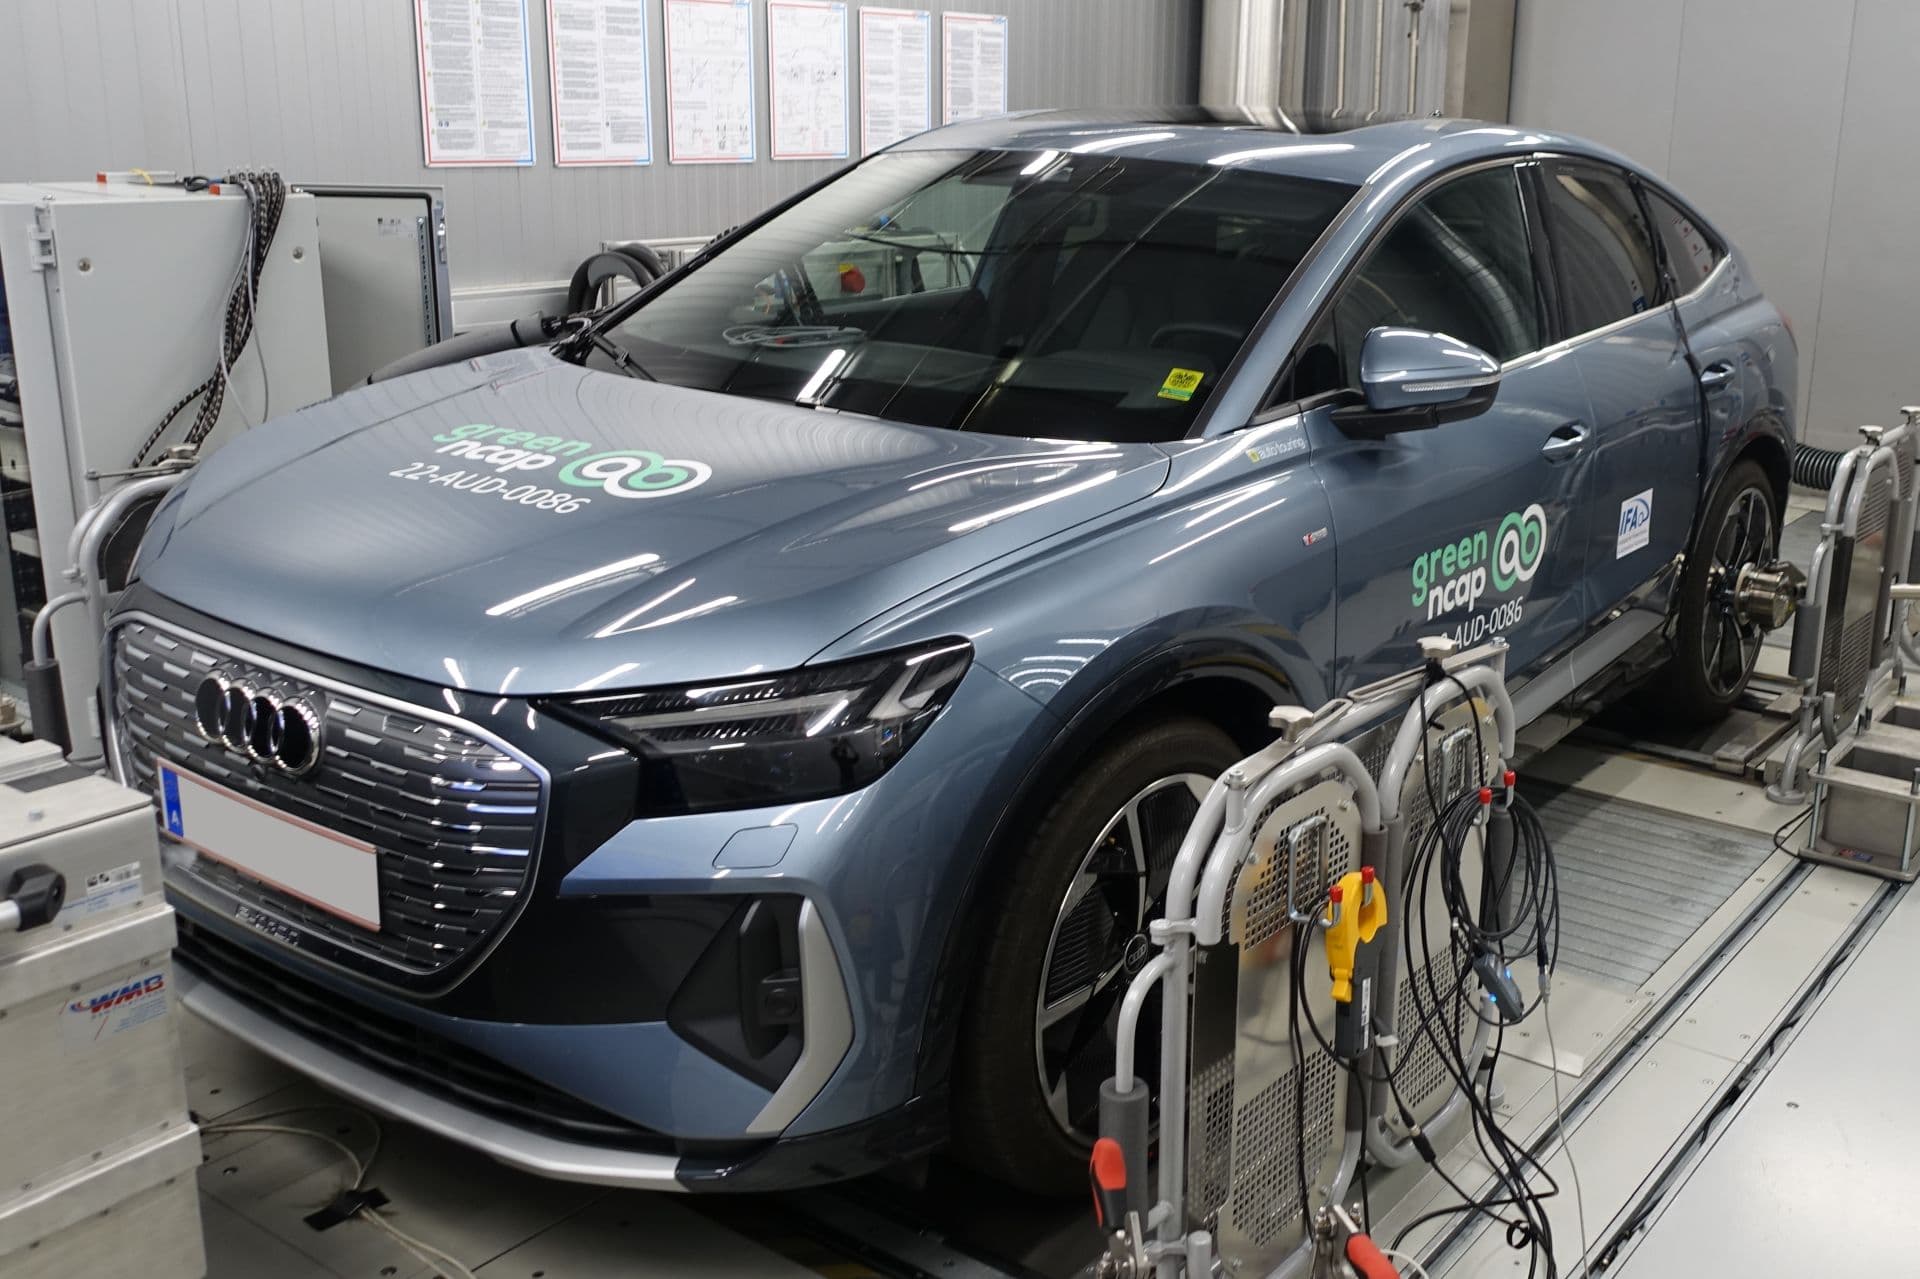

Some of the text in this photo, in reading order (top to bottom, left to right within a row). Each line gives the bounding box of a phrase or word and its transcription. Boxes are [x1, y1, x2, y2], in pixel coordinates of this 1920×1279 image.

[433, 422, 592, 457] green
[436, 439, 556, 473] ncap
[388, 461, 592, 514] 22-AUD-0086
[1619, 506, 1639, 536] IFA
[1411, 529, 1487, 607] green
[1427, 566, 1486, 621] ncap
